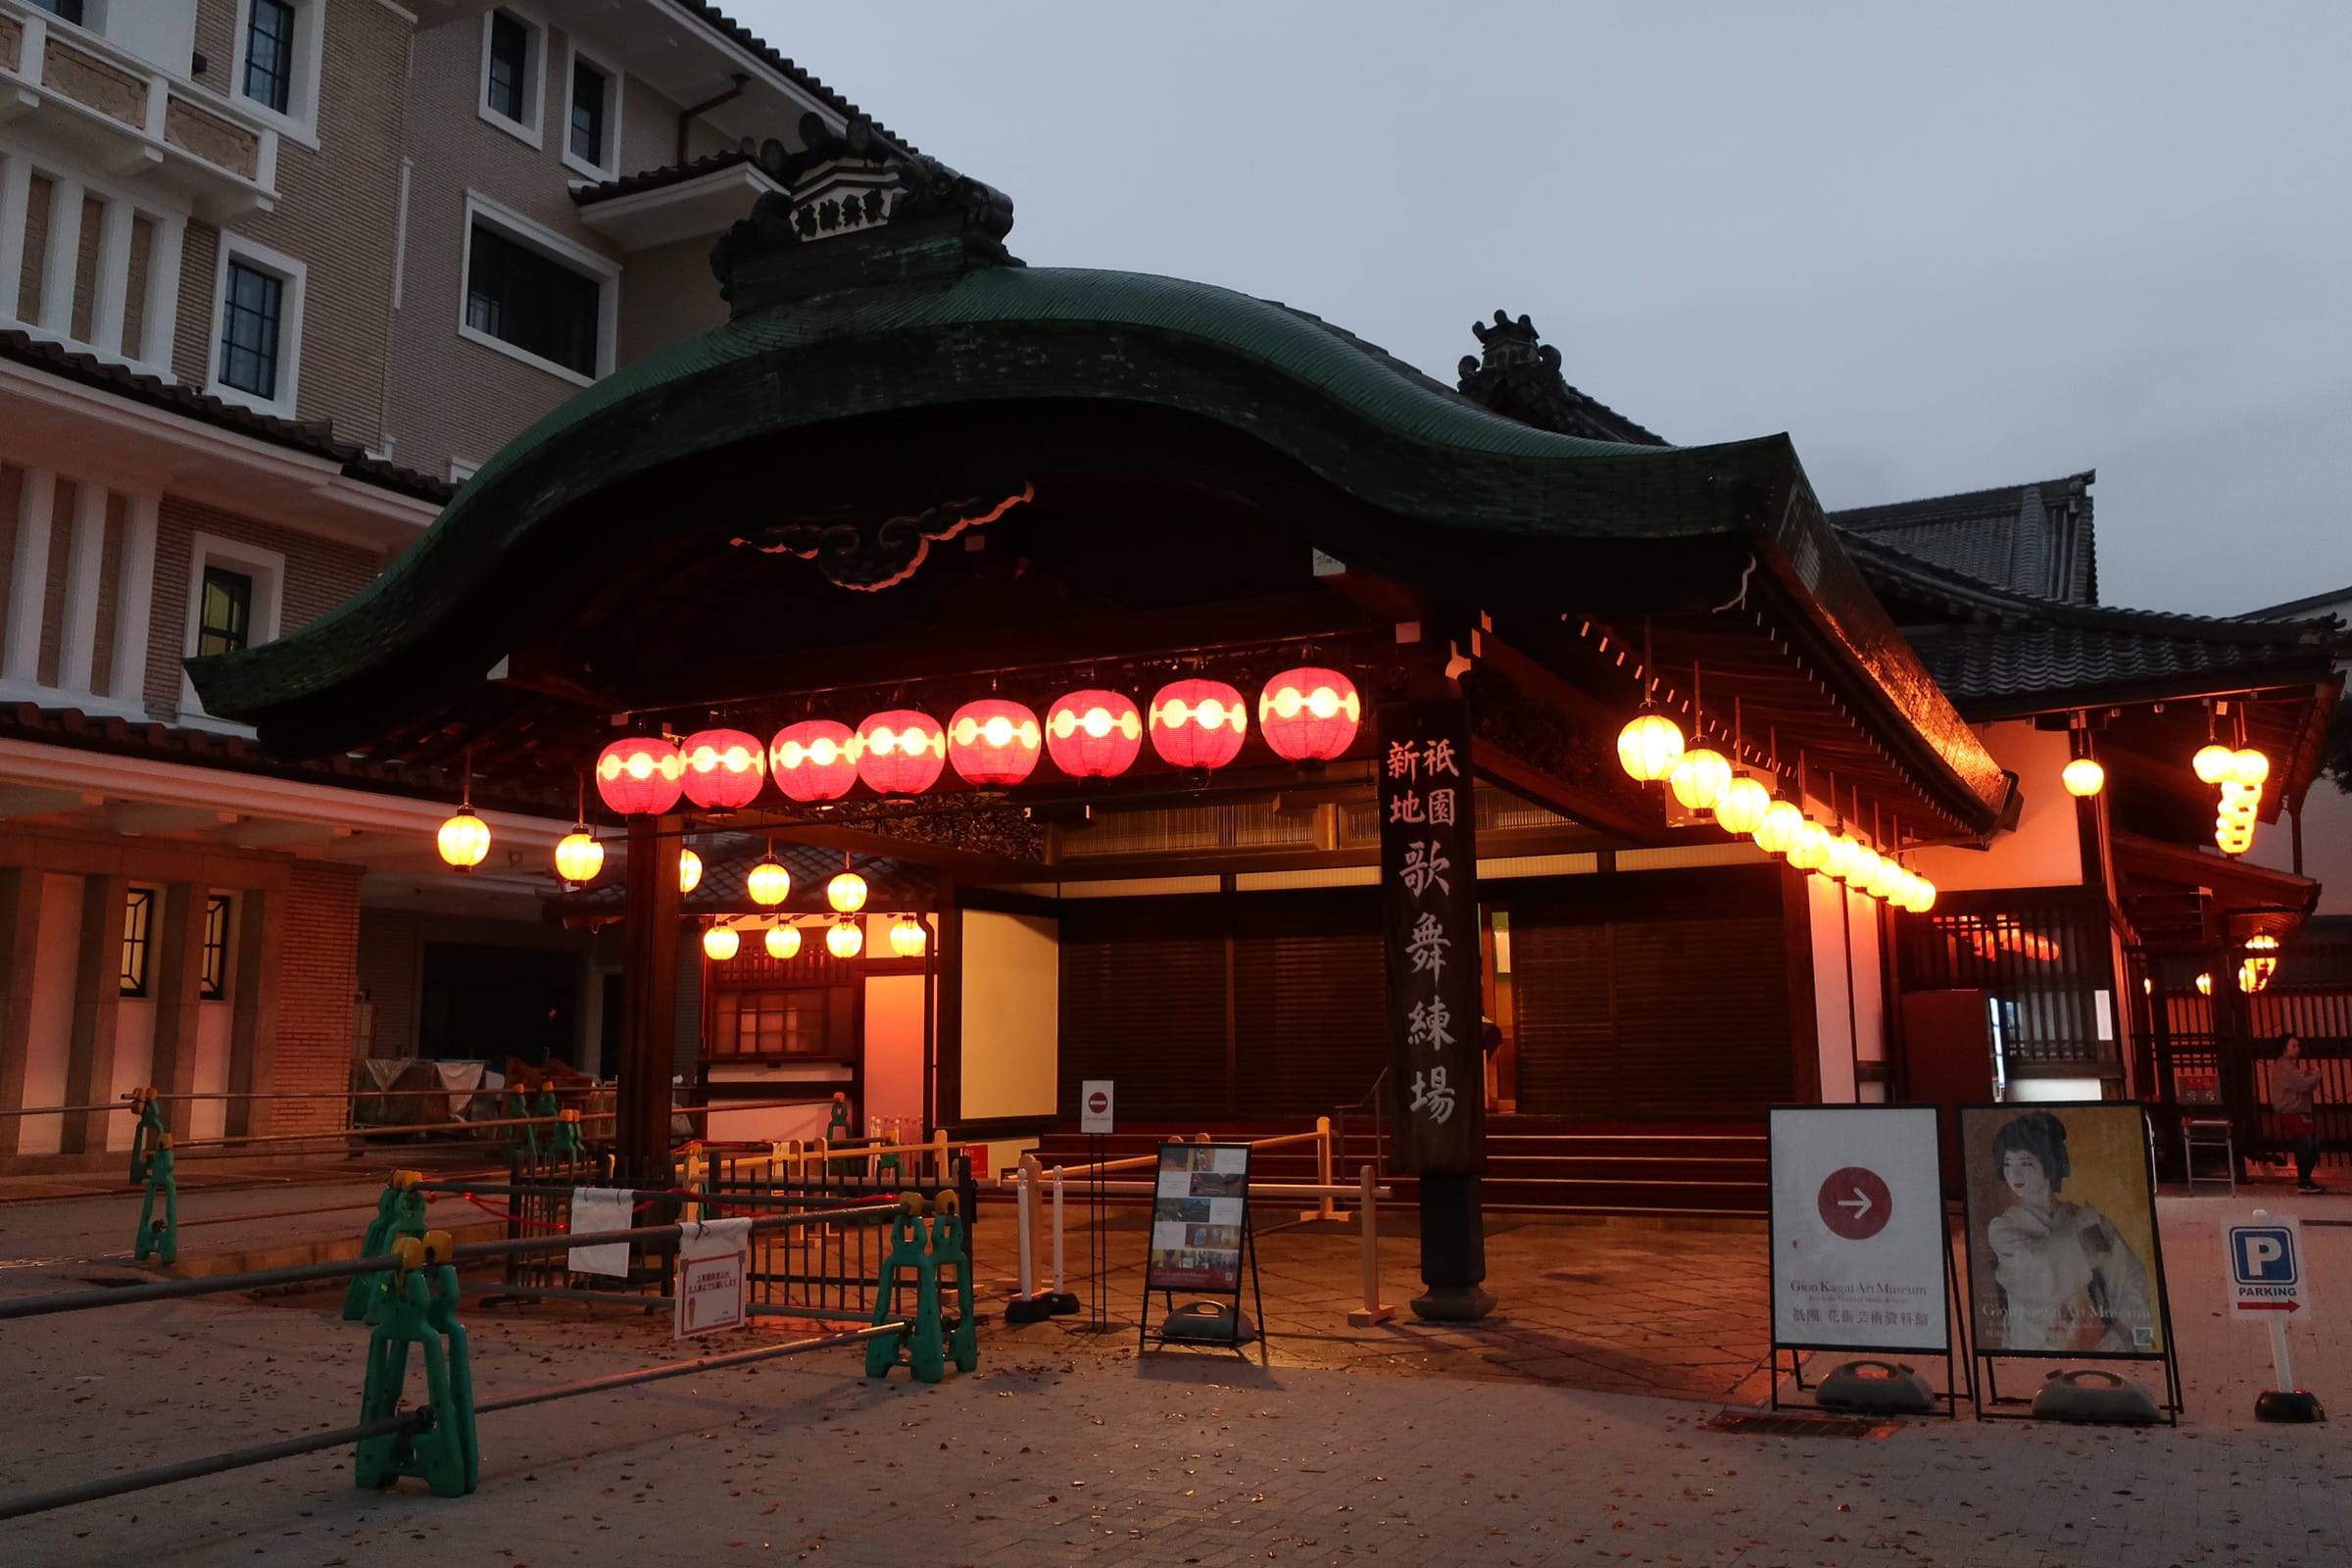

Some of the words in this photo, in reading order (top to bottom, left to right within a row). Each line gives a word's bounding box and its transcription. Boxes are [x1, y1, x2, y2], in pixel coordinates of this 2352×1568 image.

[1398, 839, 1457, 1126] 歌舞練場
[2244, 1237, 2281, 1276] P
[1790, 1280, 1818, 1293] Gion
[1857, 1282, 1874, 1294] Art
[1877, 1282, 1927, 1296] Museum
[2238, 1287, 2296, 1297] PARKING
